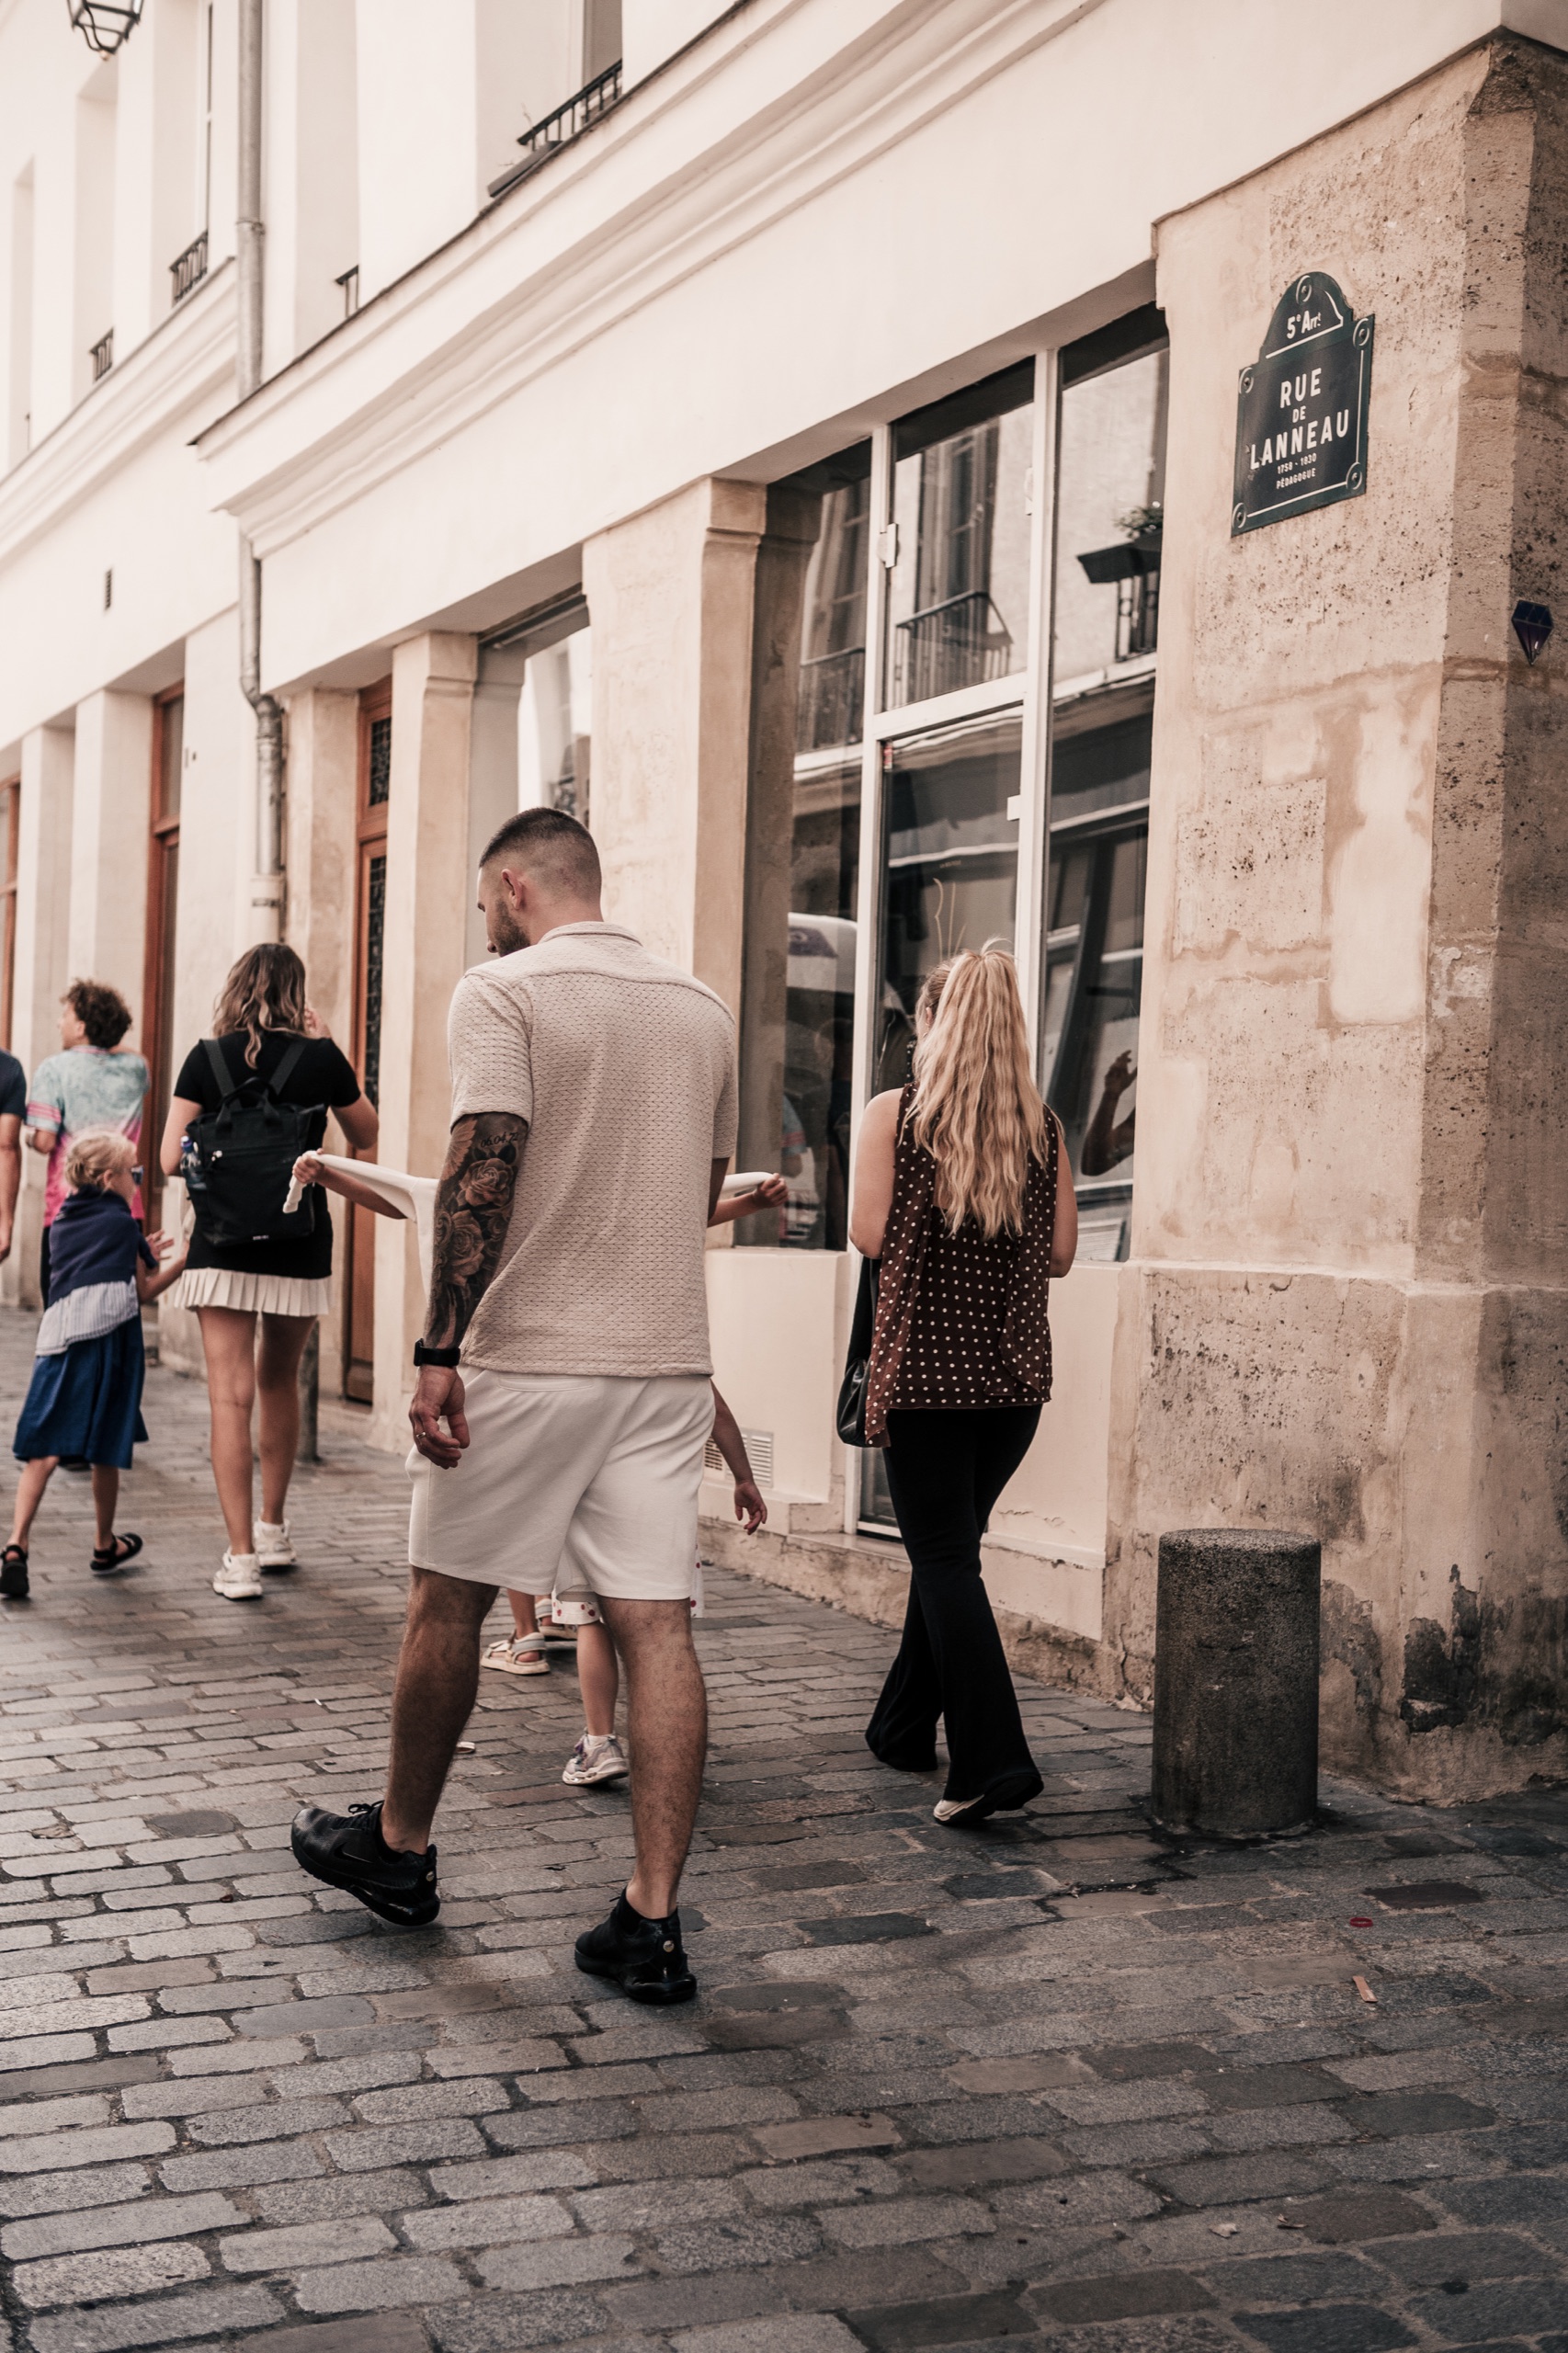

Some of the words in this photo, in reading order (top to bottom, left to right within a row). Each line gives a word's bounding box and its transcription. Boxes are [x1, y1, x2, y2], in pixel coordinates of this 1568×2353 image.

[1279, 367, 1322, 409] RUE
[1291, 404, 1306, 424] DE
[1250, 409, 1349, 471] LANNEAU
[1277, 460, 1293, 474] 1758
[1300, 452, 1317, 467] 1830
